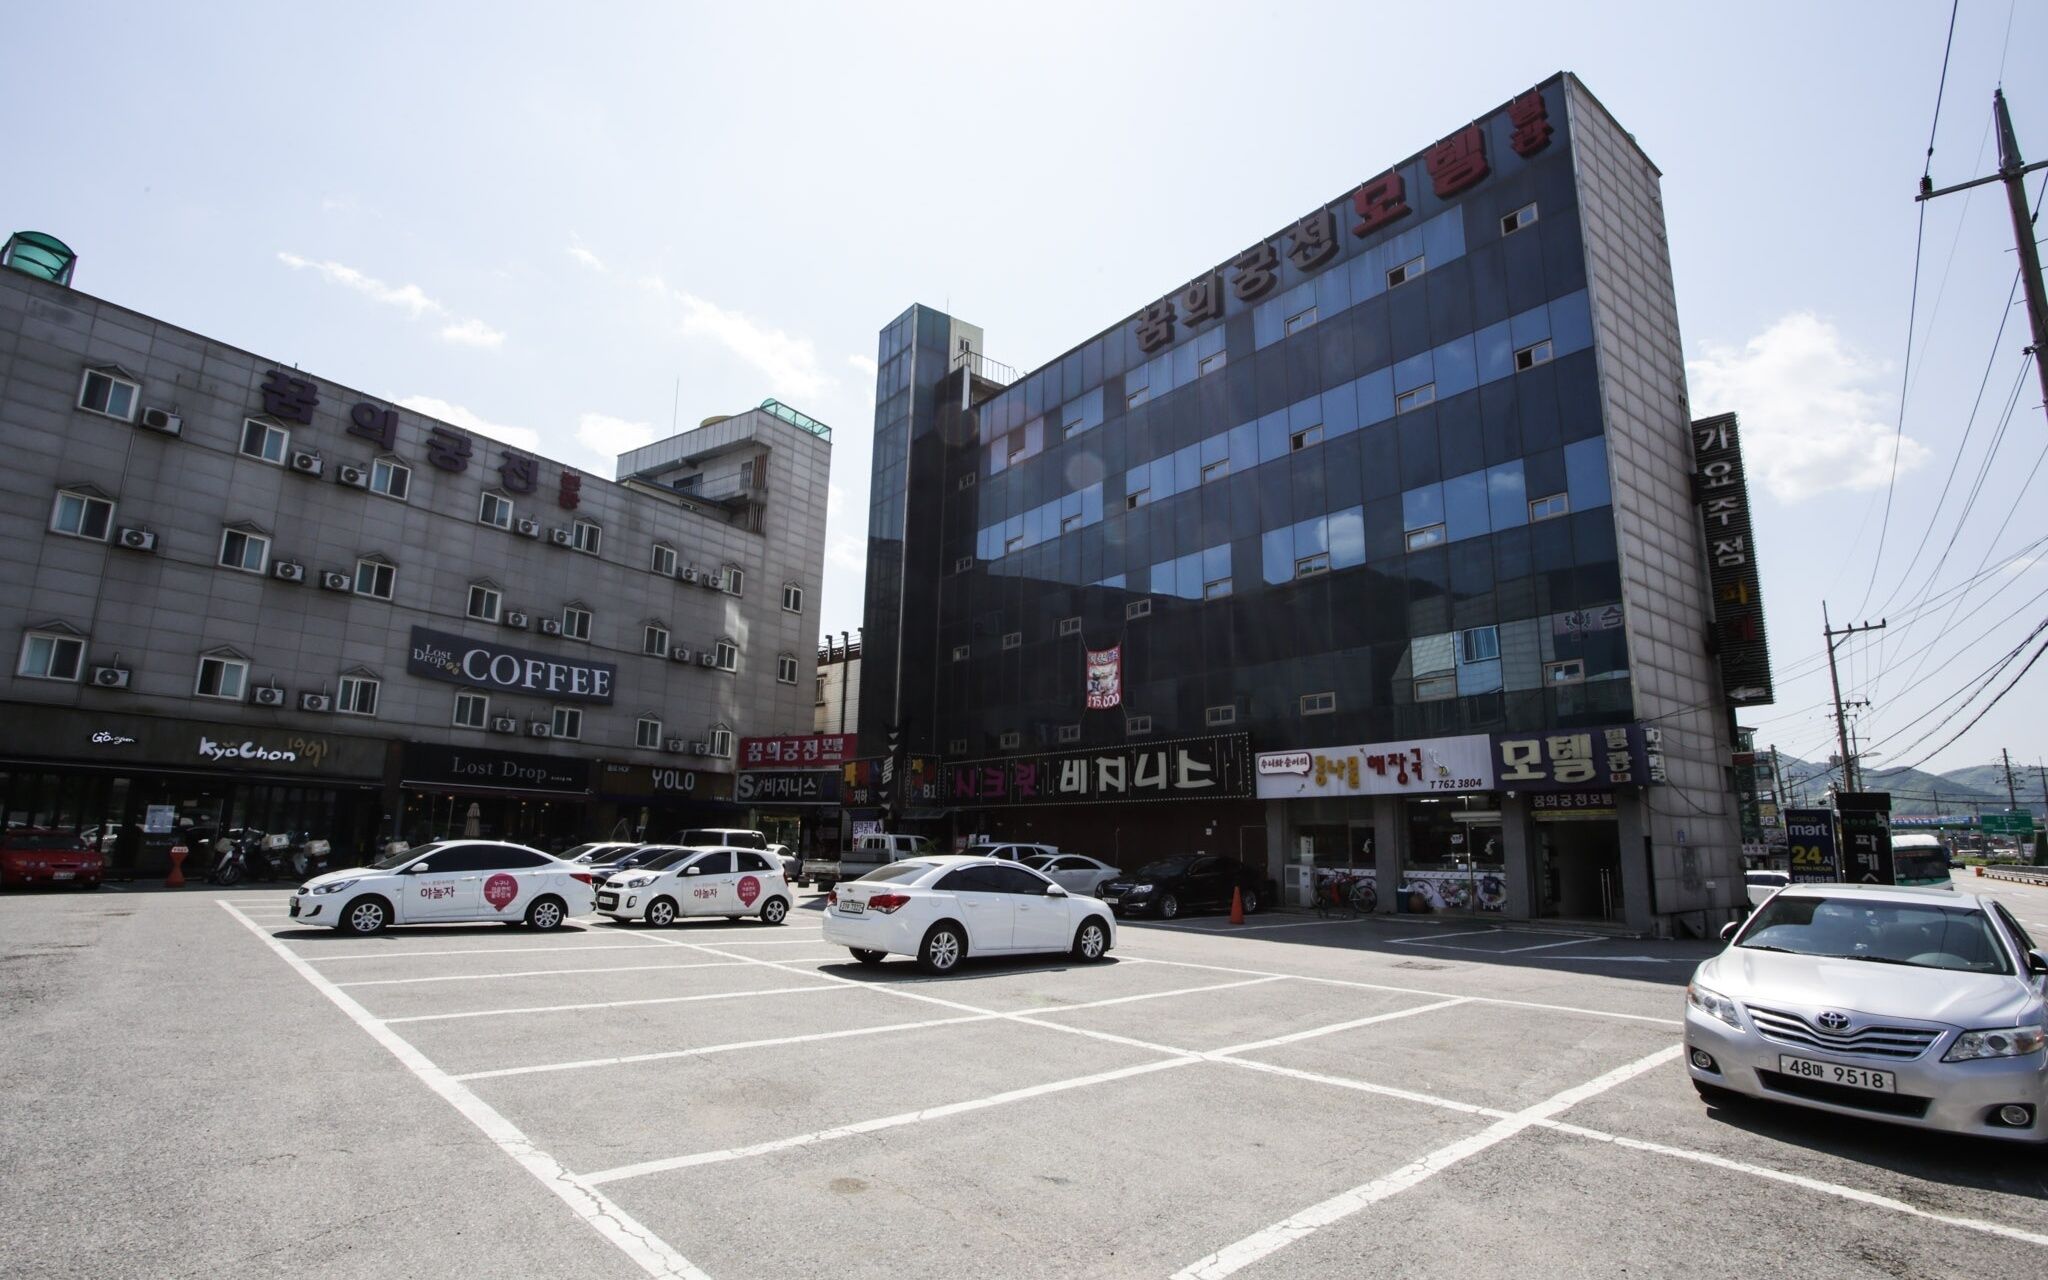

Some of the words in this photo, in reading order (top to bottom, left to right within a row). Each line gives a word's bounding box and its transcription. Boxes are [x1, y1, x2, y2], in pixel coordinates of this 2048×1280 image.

[1135, 210, 1338, 352] 꿈의궁전
[1353, 125, 1490, 238] 모텔
[261, 370, 539, 493] 꿈의궁전
[1701, 423, 1746, 567] 가요주점
[414, 648, 446, 668] Drop
[426, 644, 451, 660] Lost
[463, 649, 610, 697] COFFEE
[748, 739, 818, 762] 꿈의궁전
[823, 738, 843, 751] 모텔
[1500, 733, 1596, 783] 모텔
[452, 757, 494, 776] Lost
[503, 761, 547, 784] Drop
[652, 768, 695, 791] YOLO
[1059, 749, 1216, 794] 비지니스
[1315, 755, 1360, 788] 콩나물
[1367, 748, 1422, 784] 해장국
[765, 777, 817, 798] 비지니스
[923, 785, 936, 798] B1
[1430, 780, 1436, 790] T
[1438, 780, 1456, 789] 762
[1457, 778, 1482, 788] 3804
[1789, 823, 1828, 836] mart
[1791, 845, 1834, 866] 24시
[421, 885, 455, 899] 야놀자
[693, 888, 718, 899] 야놀자
[1790, 1059, 1824, 1079] 48마
[1834, 1067, 1884, 1089] 9518
